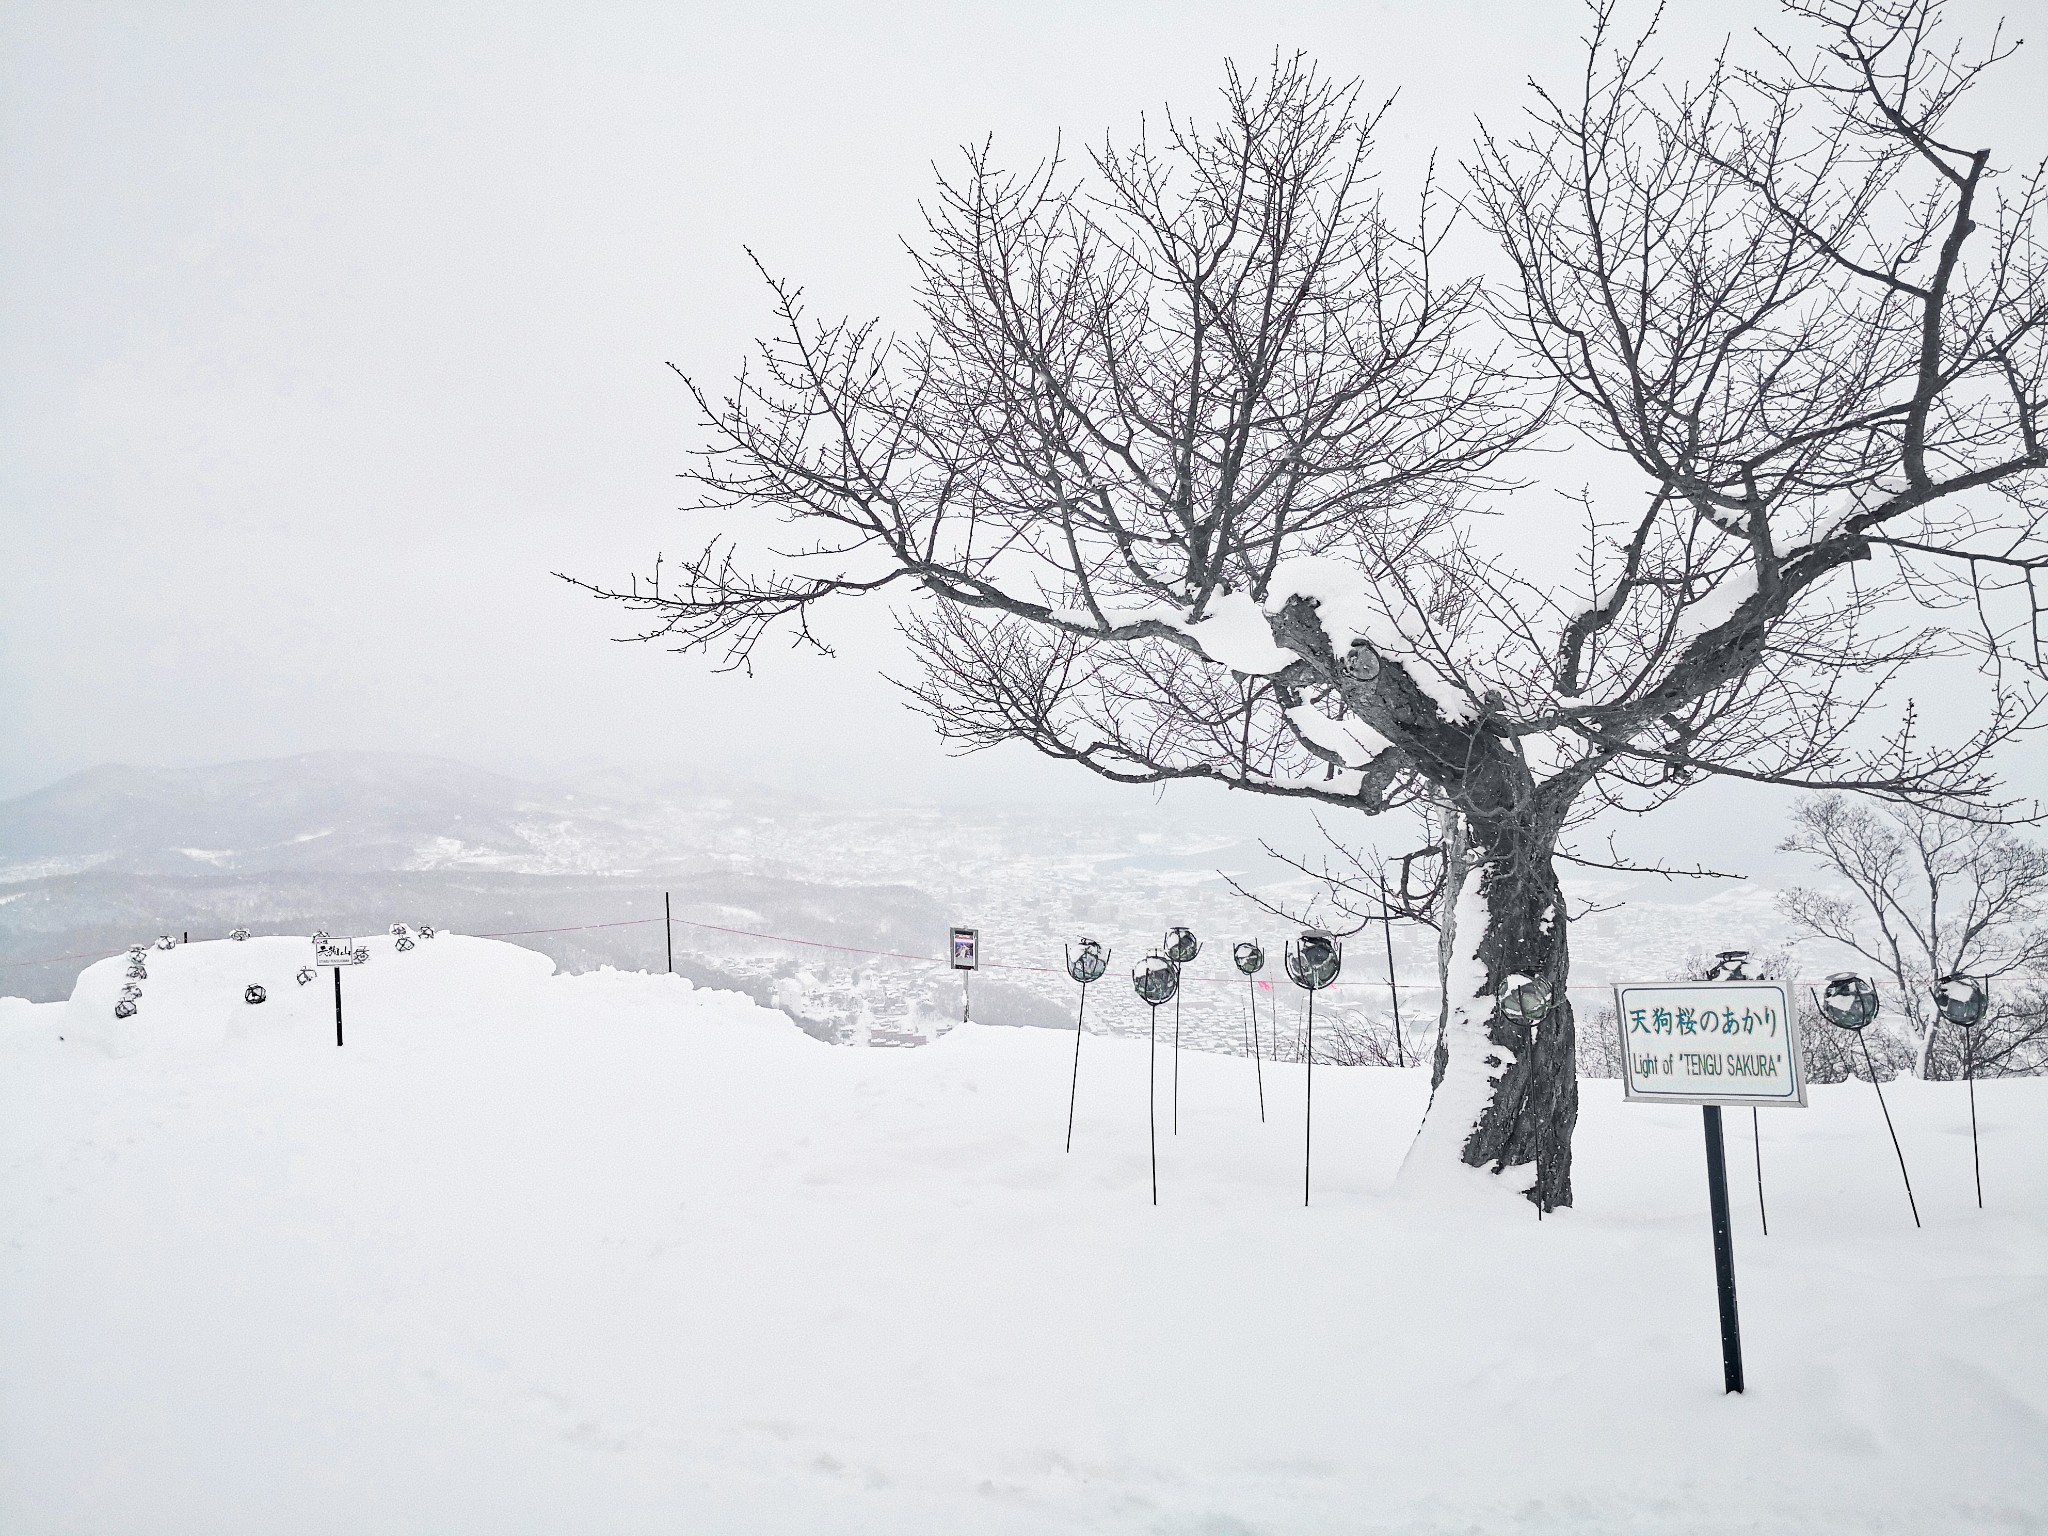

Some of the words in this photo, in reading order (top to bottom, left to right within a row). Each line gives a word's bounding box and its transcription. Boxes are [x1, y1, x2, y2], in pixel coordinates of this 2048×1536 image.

[1629, 1005, 1777, 1037] 天狗桜のあかり
[1633, 1053, 1658, 1079] Light
[1662, 1053, 1674, 1075] of
